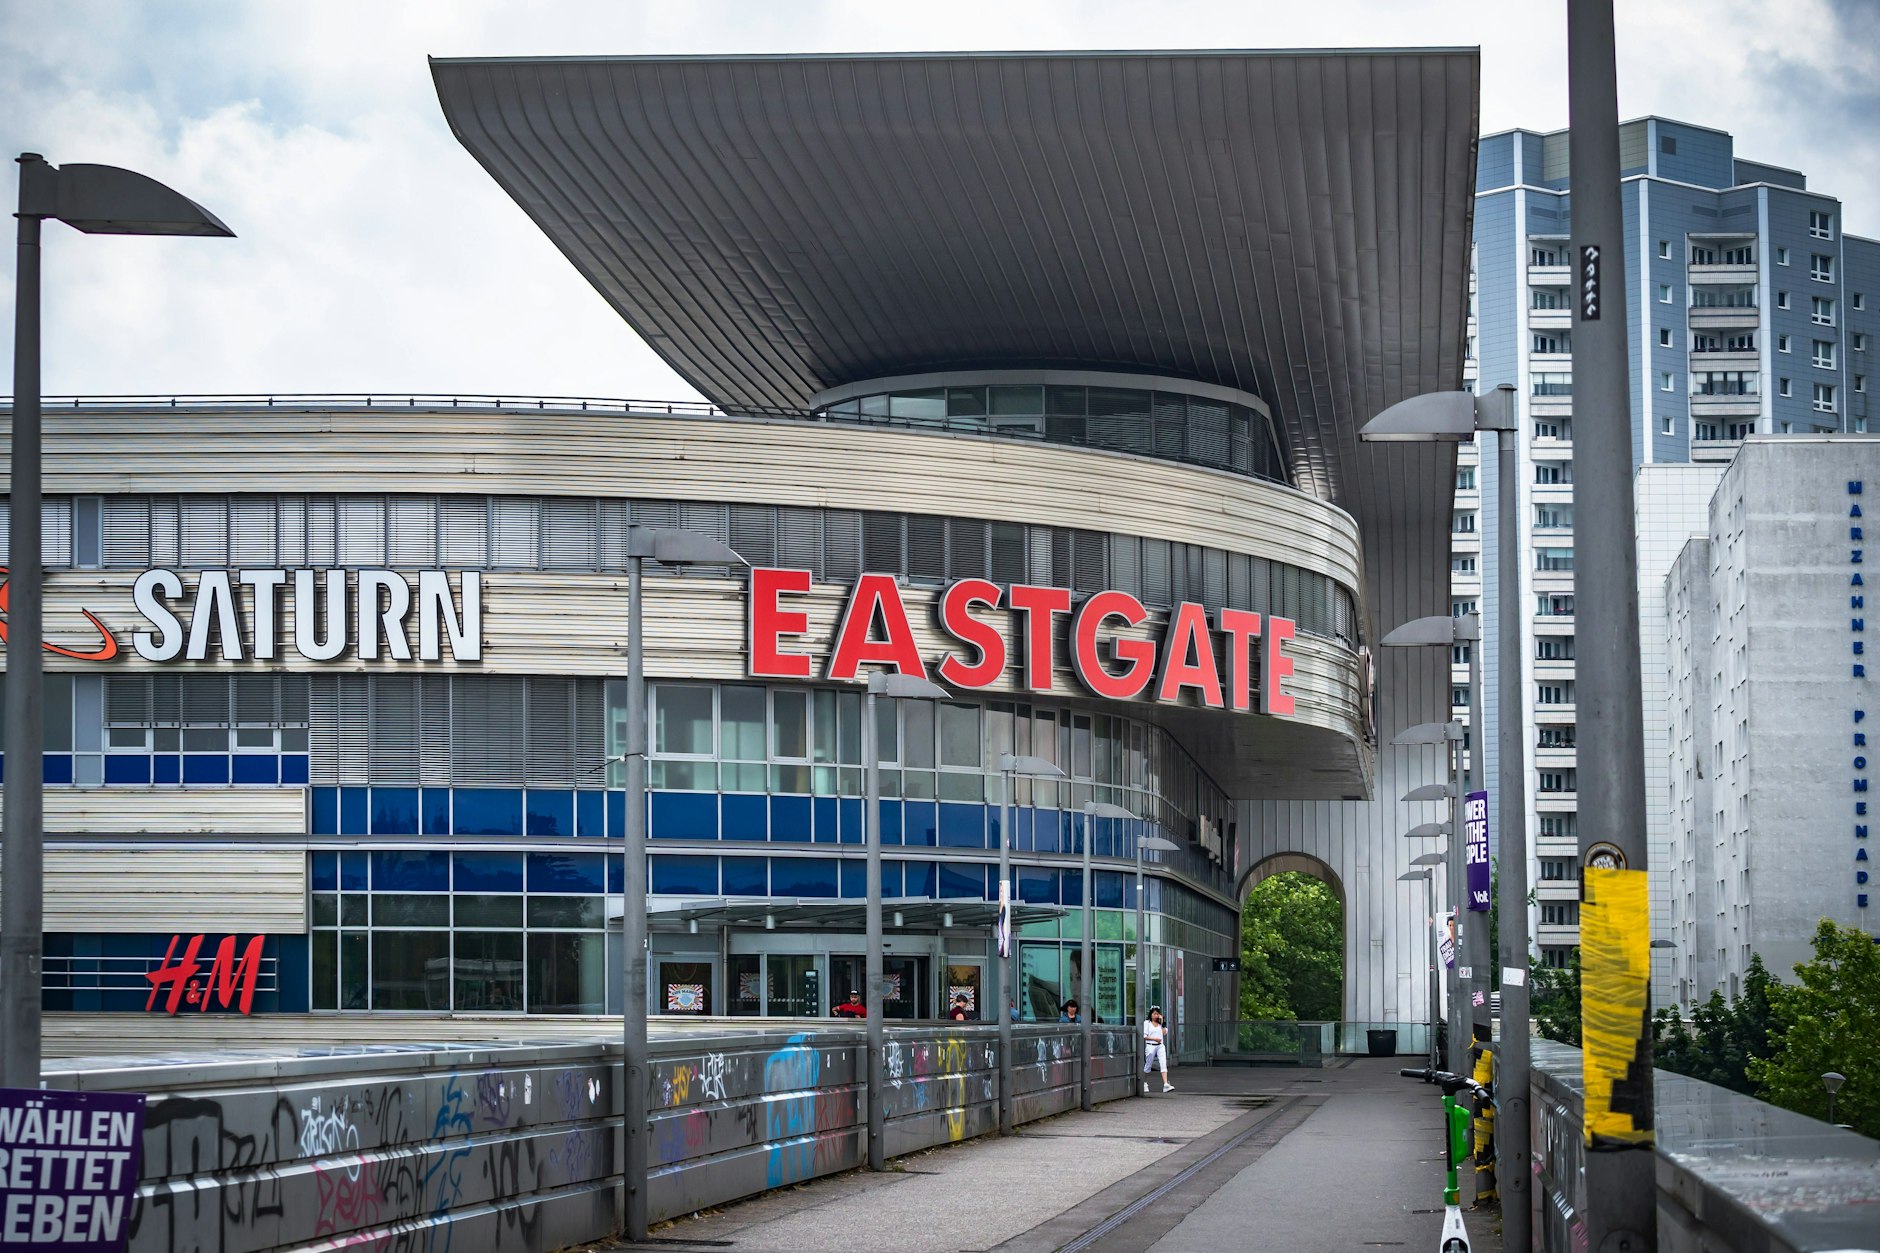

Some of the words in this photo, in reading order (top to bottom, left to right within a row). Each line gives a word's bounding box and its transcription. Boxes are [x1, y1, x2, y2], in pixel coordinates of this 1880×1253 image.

[1848, 481, 1866, 678] MARZAHNER
[132, 568, 482, 662] SATURN
[748, 566, 1296, 717] EASTGATE
[1465, 799, 1486, 822] WER
[1853, 710, 1869, 907] PROMENADE
[1466, 843, 1487, 865] OPLE
[1473, 891, 1489, 903] Volt
[145, 934, 265, 1016] H&M
[0, 1100, 136, 1147] WÄHLEN
[0, 1194, 125, 1244] EBEN
